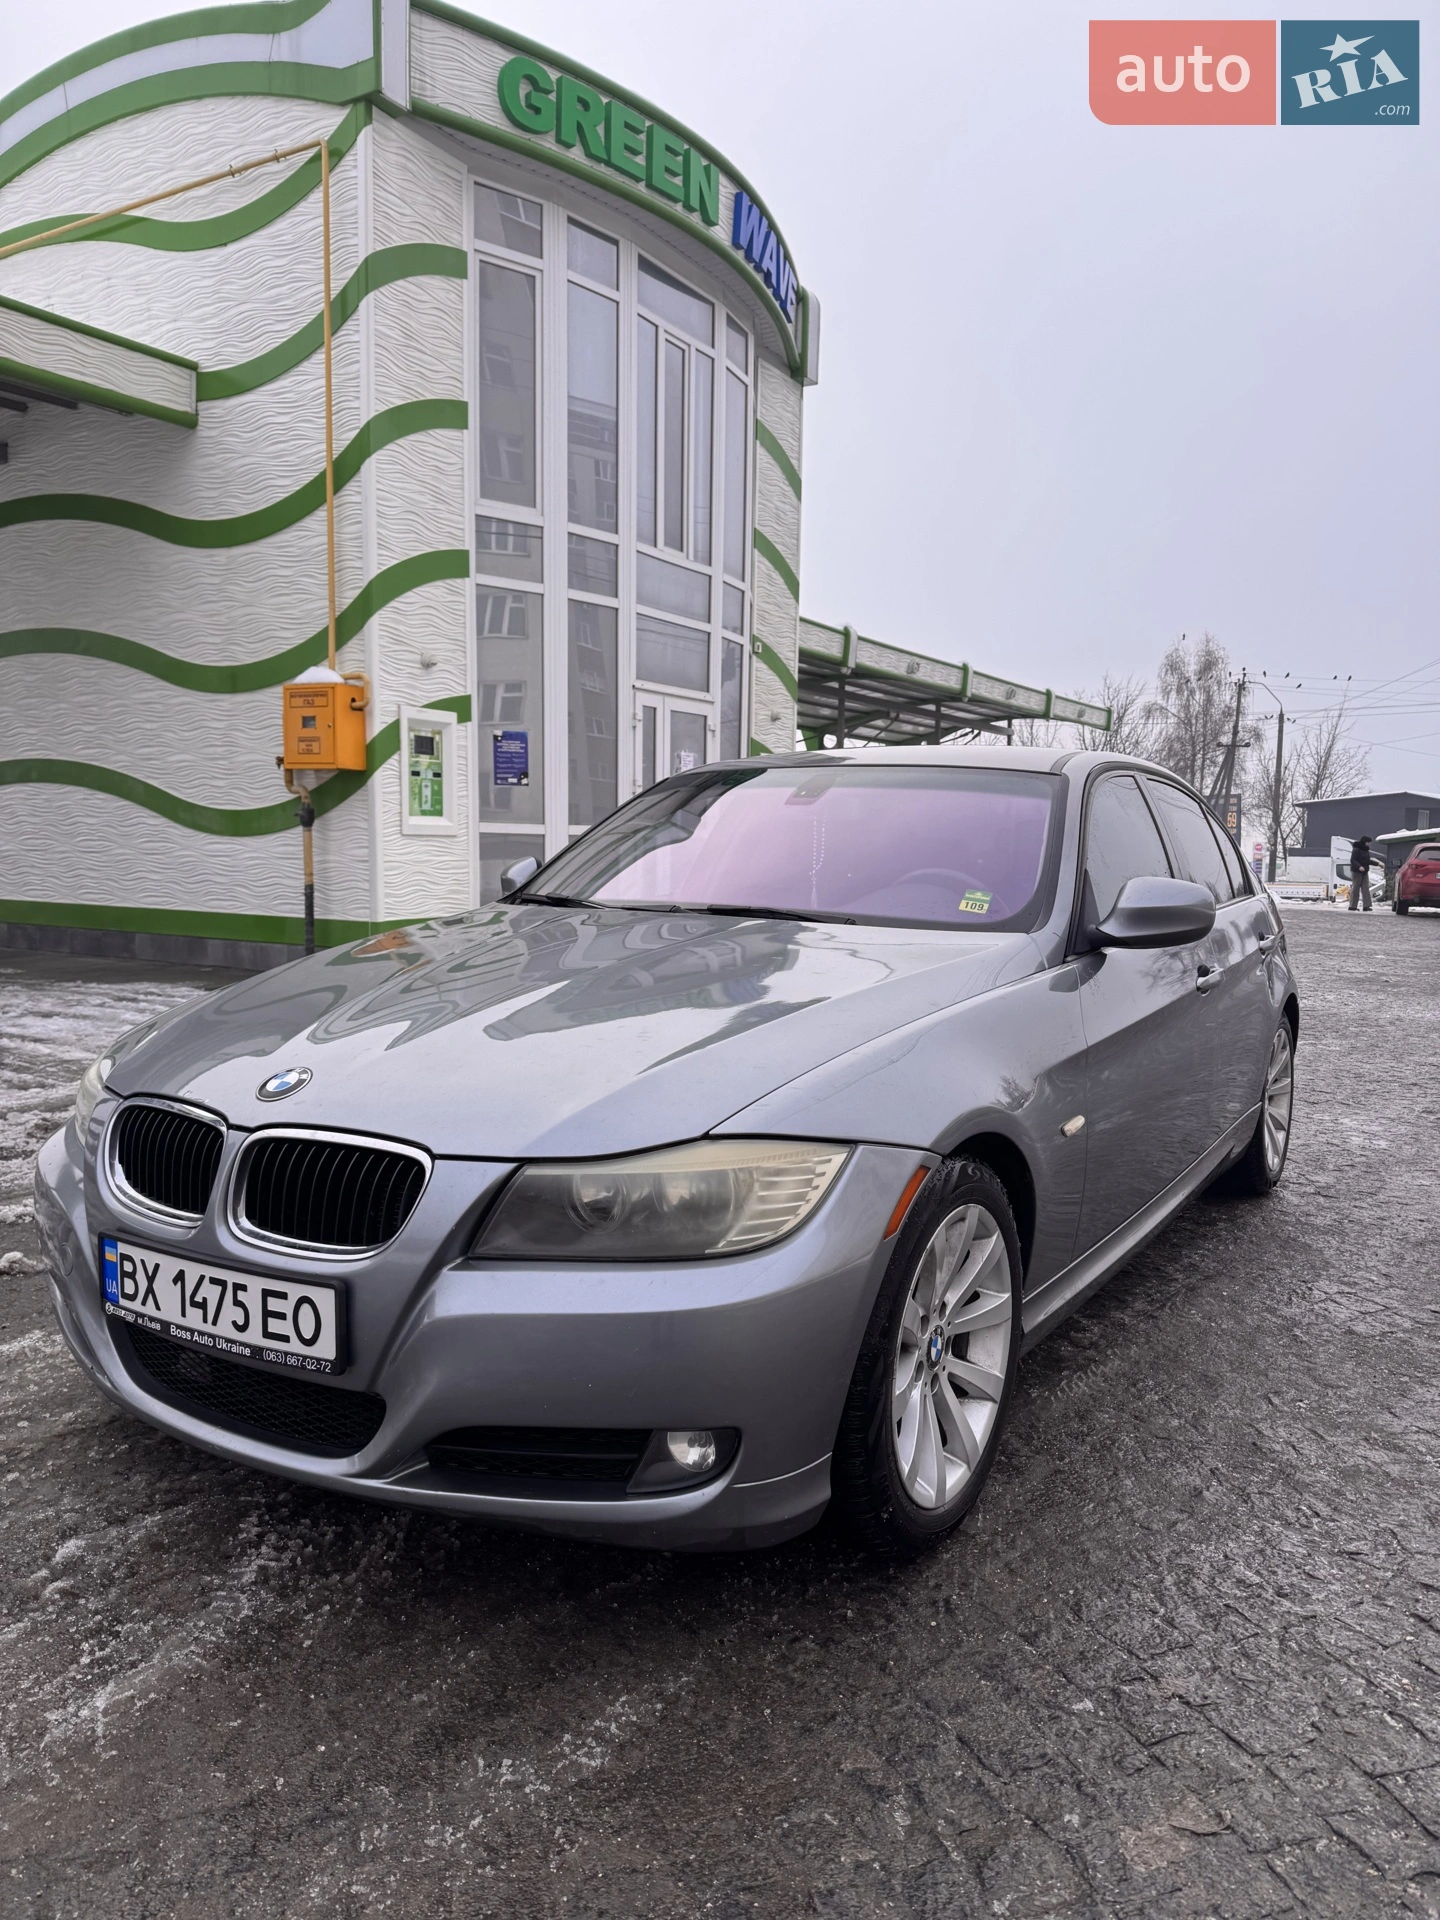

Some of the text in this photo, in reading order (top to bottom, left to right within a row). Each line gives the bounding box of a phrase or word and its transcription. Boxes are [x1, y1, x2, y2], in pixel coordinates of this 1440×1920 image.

[497, 55, 798, 323] GREEN WAVE
[964, 901, 985, 911] 109
[106, 1277, 118, 1296] UA
[119, 1252, 322, 1347] BX 1475 EO
[170, 1324, 251, 1356] Boss Auto Ukraine
[263, 1348, 331, 1373] (063) 667-02-72
